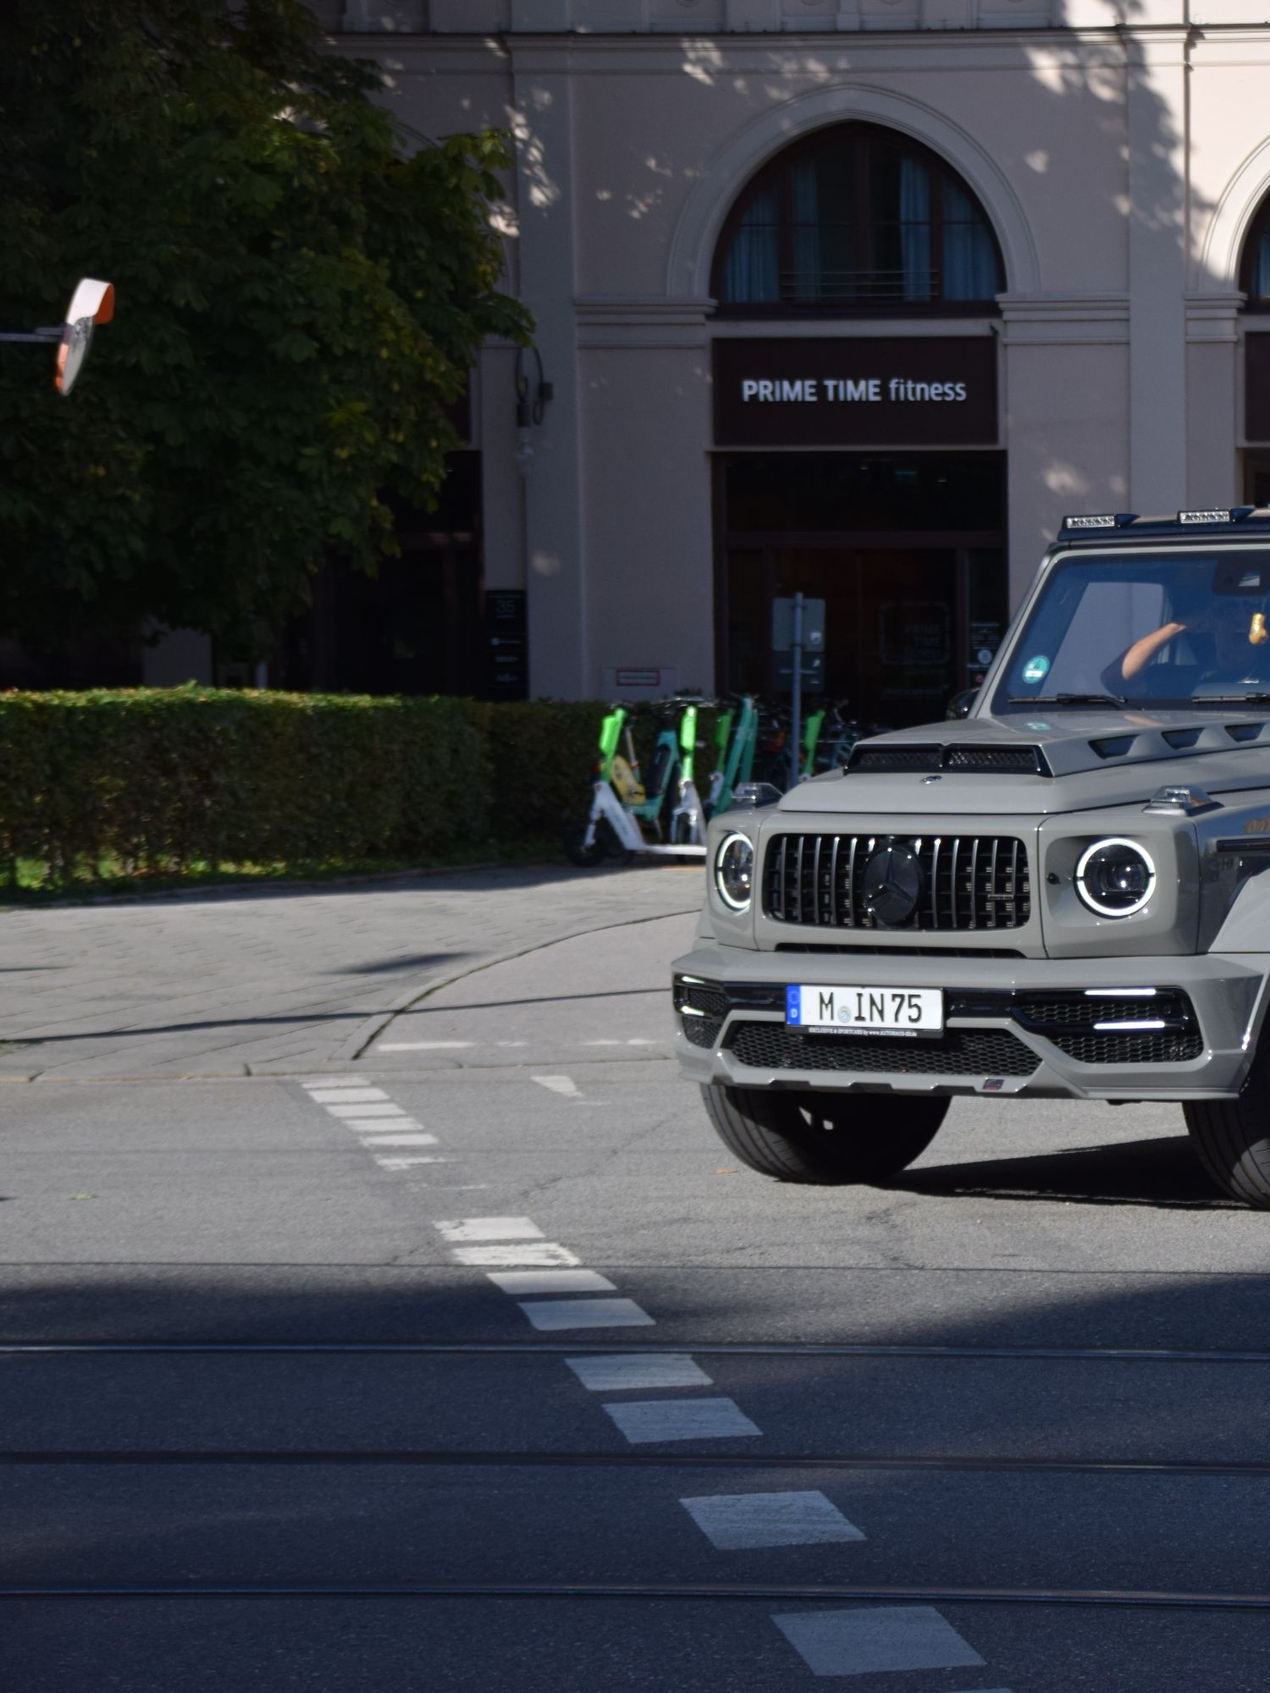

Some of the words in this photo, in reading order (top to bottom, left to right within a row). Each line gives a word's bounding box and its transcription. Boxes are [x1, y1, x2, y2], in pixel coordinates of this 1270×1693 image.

[742, 379, 818, 402] PRIME
[824, 379, 882, 402] TIME
[889, 378, 967, 402] fitness
[819, 991, 834, 1021] M
